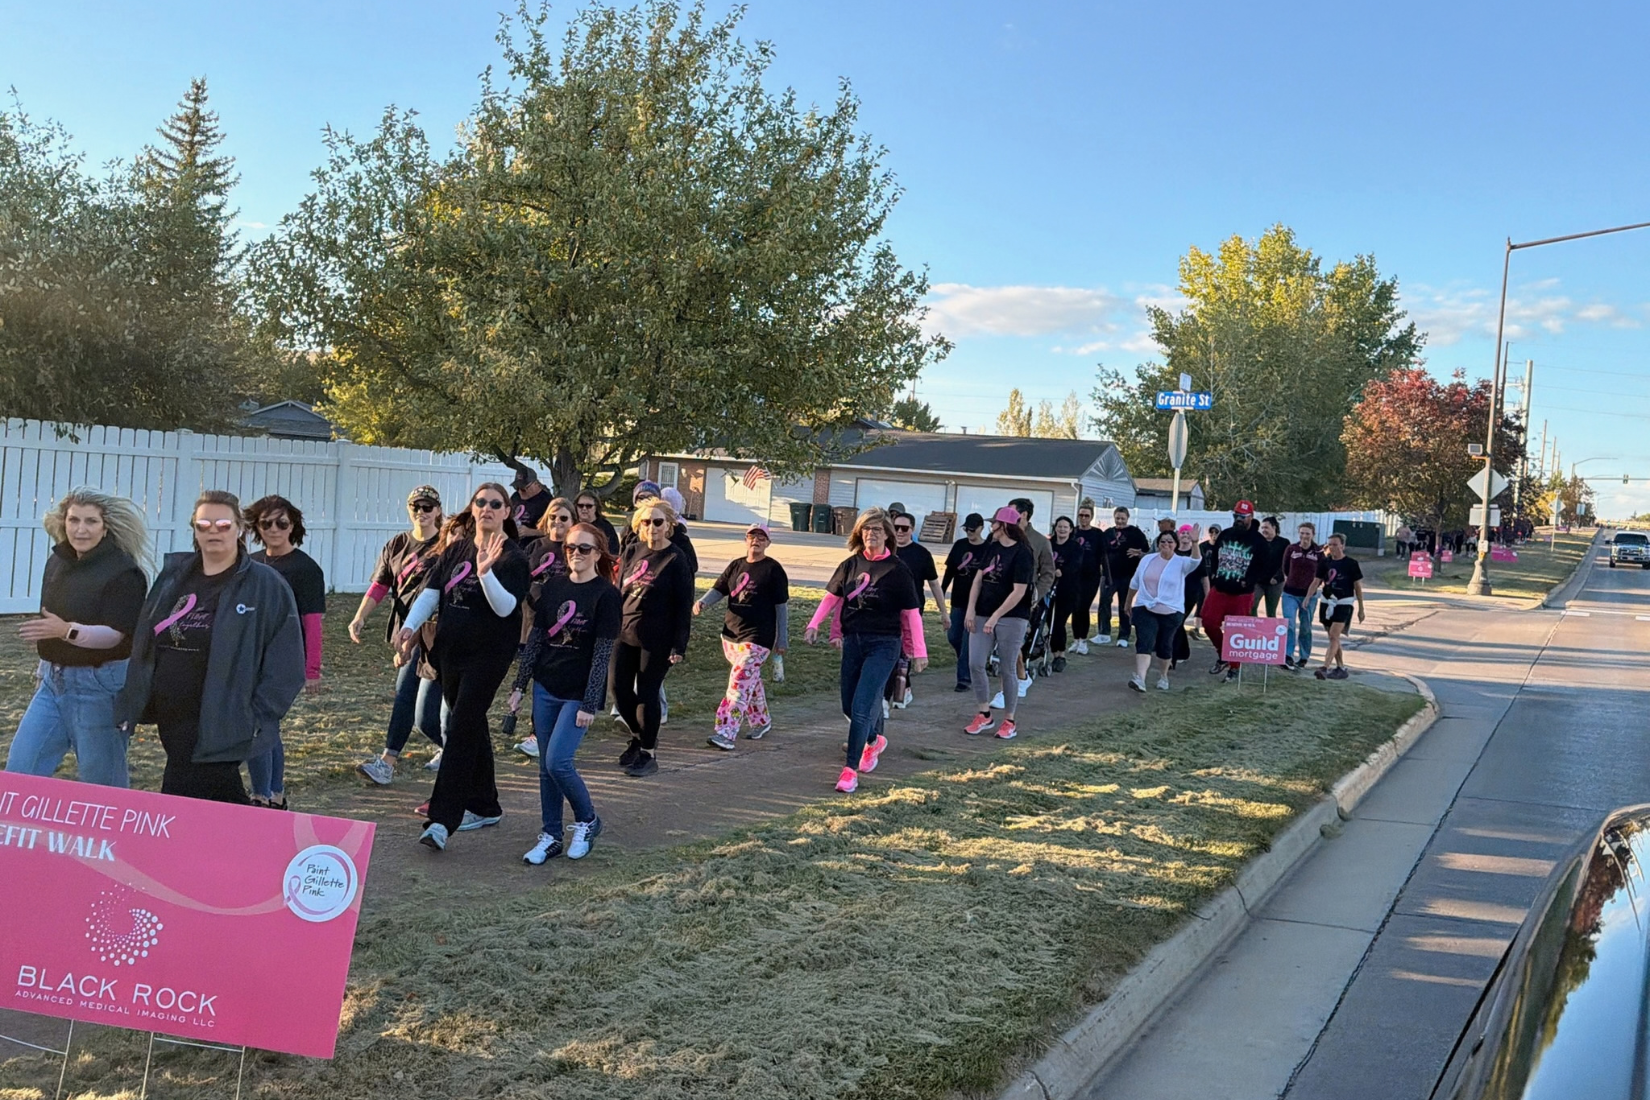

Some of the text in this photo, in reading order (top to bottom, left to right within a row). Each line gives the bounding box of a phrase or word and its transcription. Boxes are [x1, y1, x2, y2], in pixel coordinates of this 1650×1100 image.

[1158, 392, 1210, 406] Granite St
[1229, 633, 1280, 652] Guild
[1228, 650, 1278, 661] mortgage
[21, 795, 118, 831] GILLETTE
[119, 808, 176, 839] PINK
[48, 831, 117, 862] WALK
[306, 863, 331, 876] Paint
[304, 875, 345, 889] Gillette
[302, 885, 326, 897] Pink
[17, 965, 219, 1017] BLACK ROCK
[14, 989, 216, 1028] ADVANCED MEDICAL IMAGING LLC
